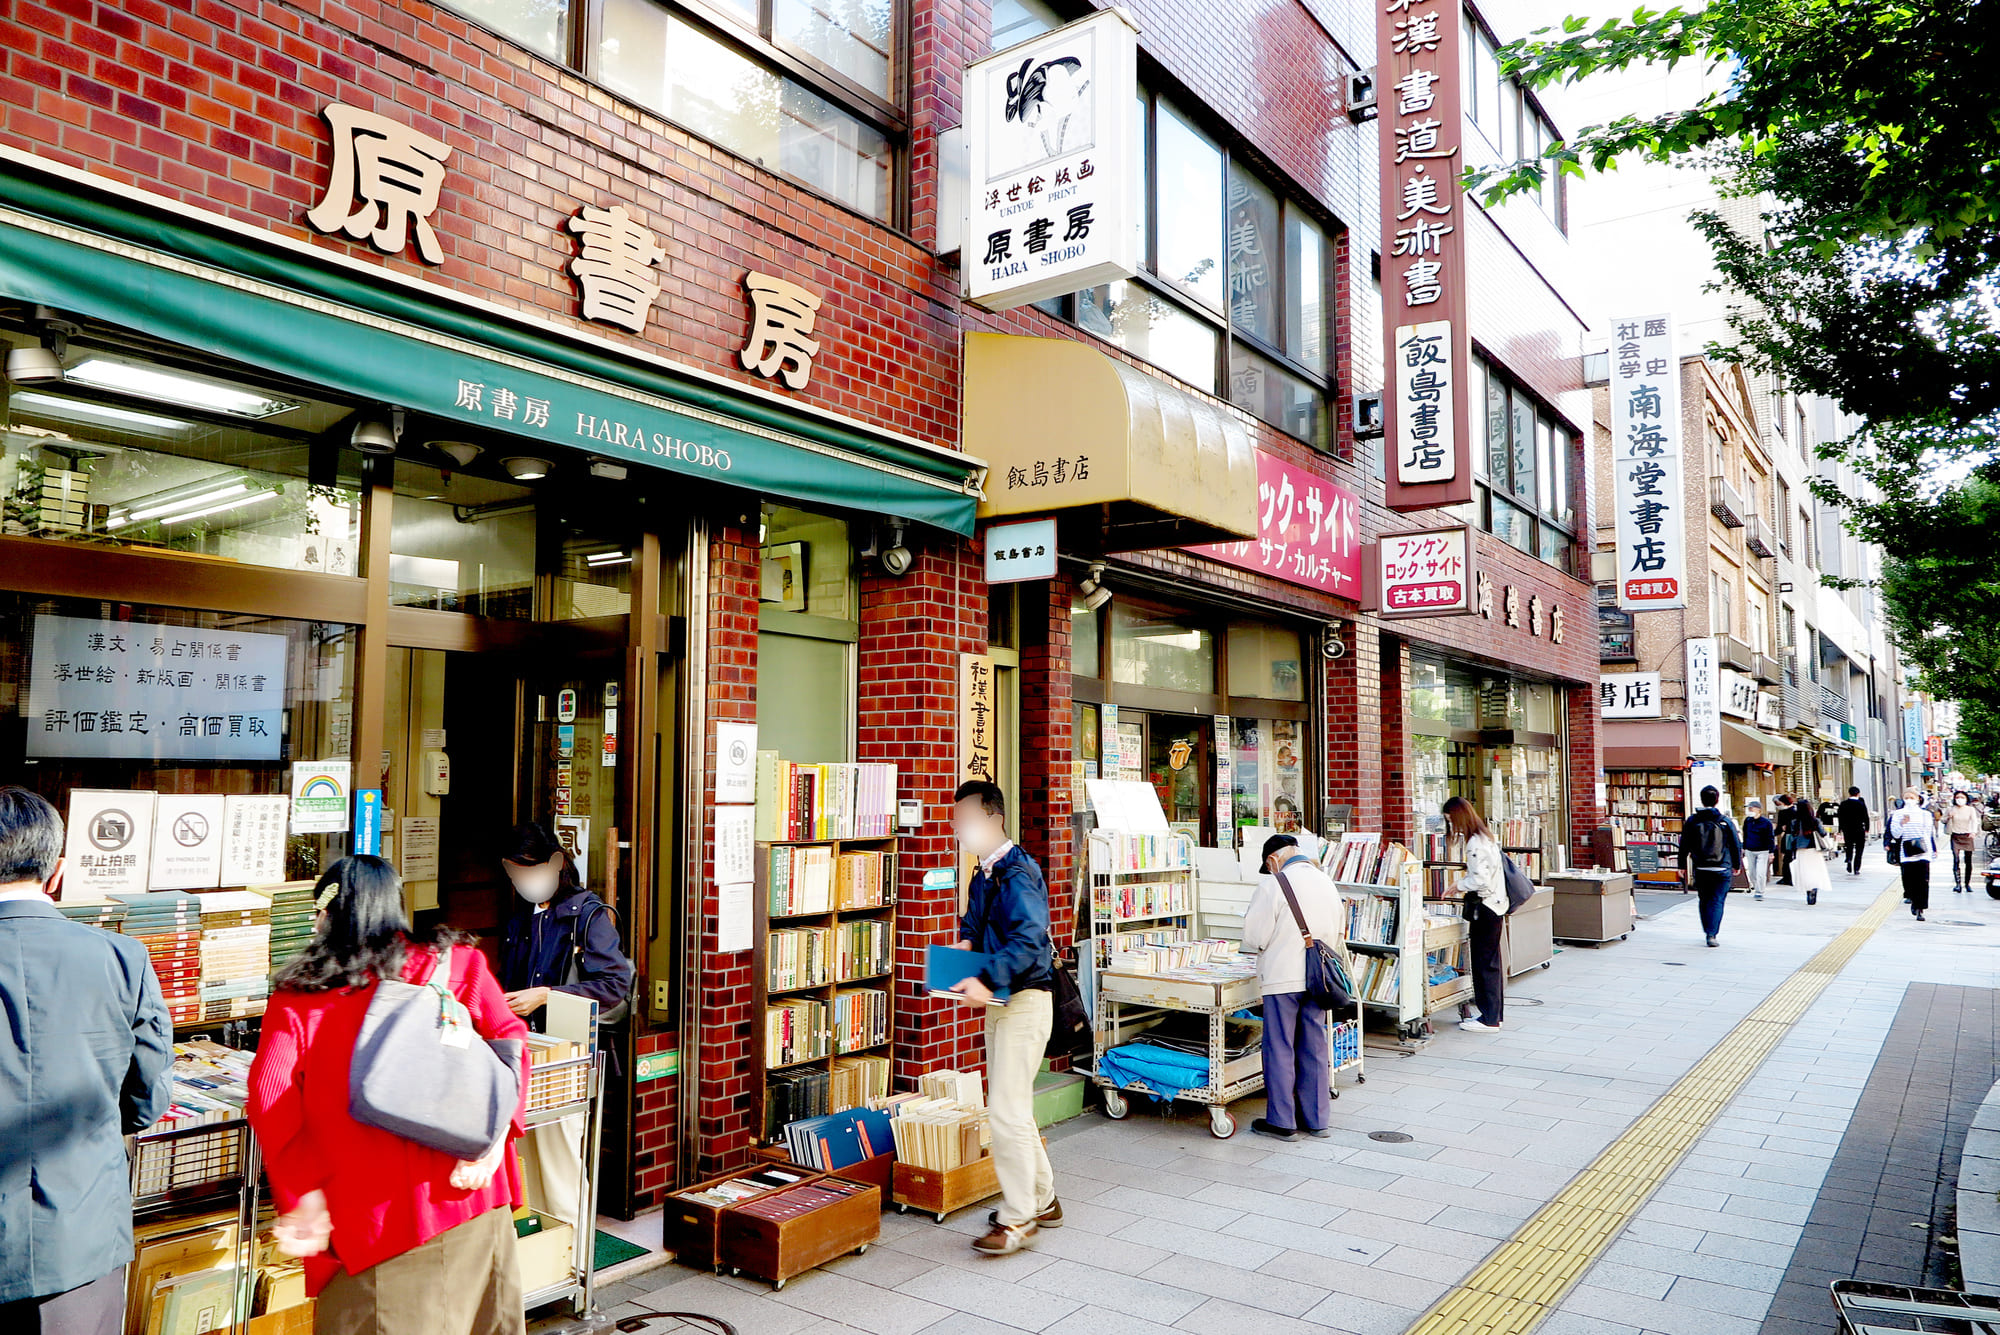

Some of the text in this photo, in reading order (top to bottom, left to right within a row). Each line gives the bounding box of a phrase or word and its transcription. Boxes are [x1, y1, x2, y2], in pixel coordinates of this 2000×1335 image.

[1000, 185, 1078, 218] UKIYOE PRINT
[305, 102, 822, 390] 原書房
[983, 202, 1095, 265] 原書房
[992, 244, 1086, 281] HARA SHOBO
[1617, 322, 1641, 379] 社会学
[1643, 318, 1669, 377] 歴史
[454, 378, 551, 428] 原書房
[575, 412, 648, 452] HARA
[1399, 334, 1447, 470] 飯島書店
[1006, 455, 1089, 490] 飯島書店
[1628, 383, 1669, 573] 南海堂書店
[993, 545, 1046, 561] 飯島書店
[1259, 538, 1353, 589] サブ・カルチャー
[1398, 538, 1449, 558] ブンケン
[1386, 556, 1462, 580] ロック・サイド
[1393, 586, 1454, 604] 古本買取
[1628, 580, 1677, 598] 古書買入
[1693, 644, 1709, 696] 矢口書店
[45, 709, 269, 738] 評価鑑定・高価買取
[79, 854, 137, 867] 禁止拍照
